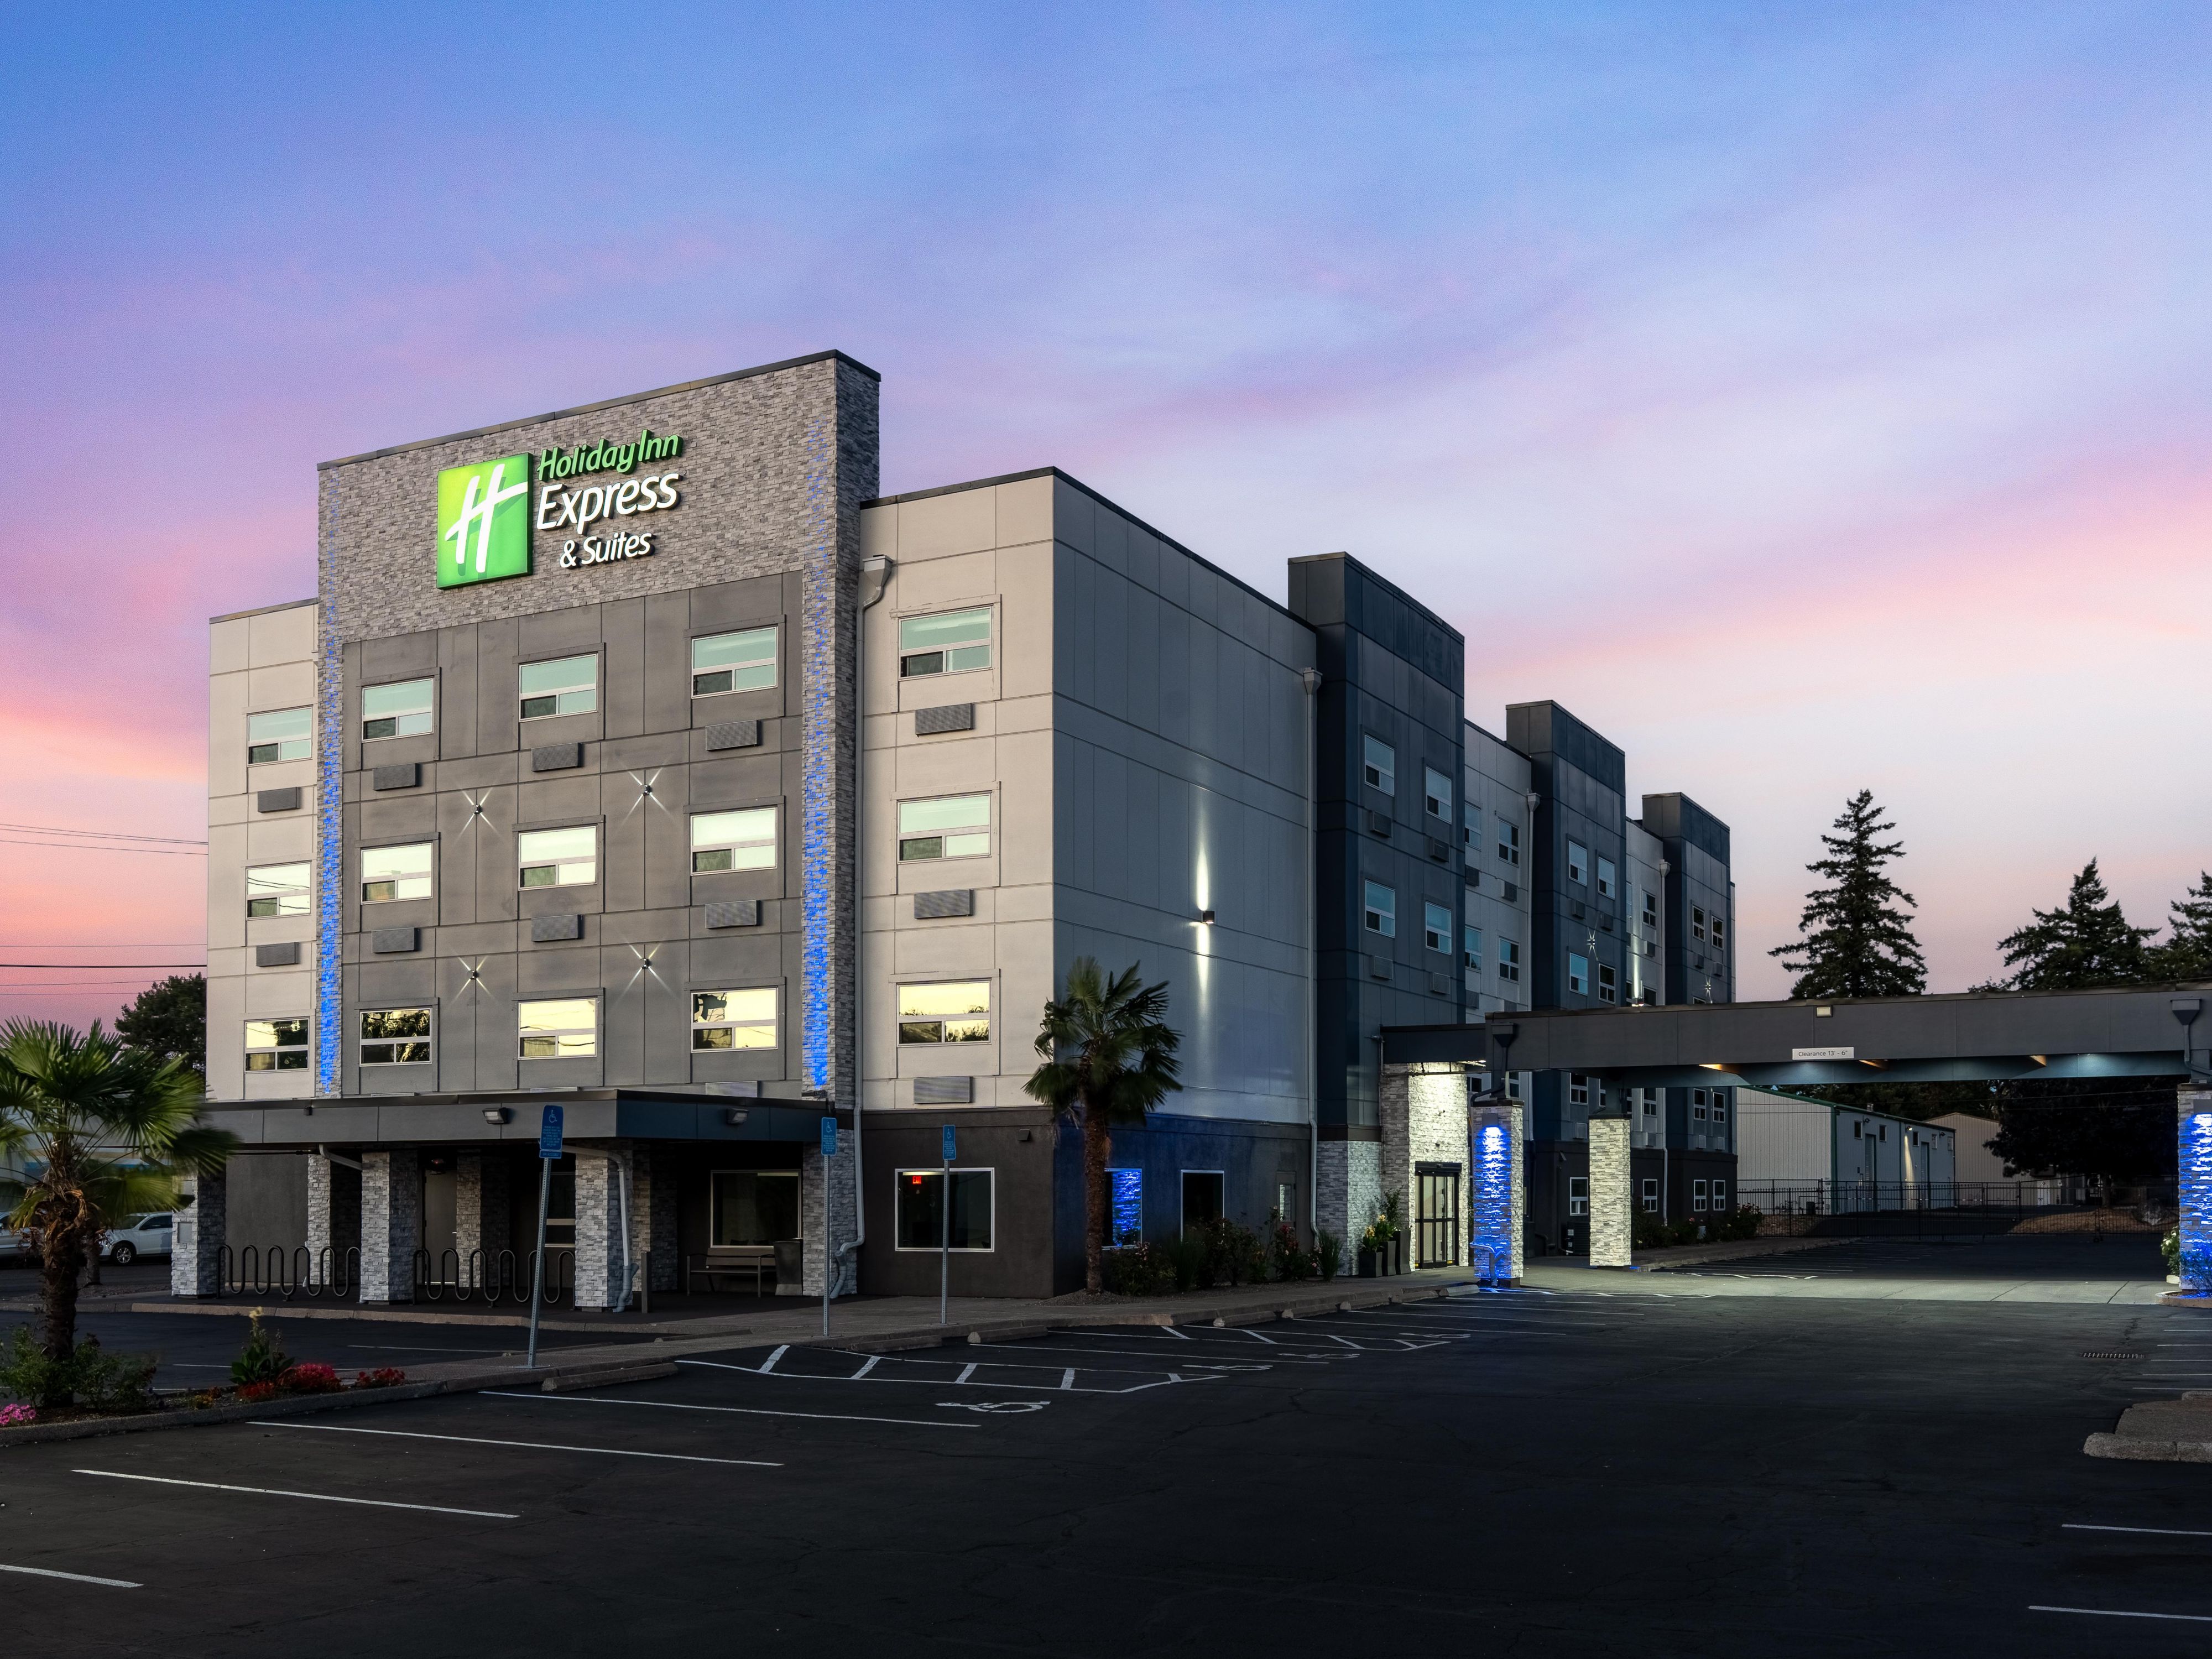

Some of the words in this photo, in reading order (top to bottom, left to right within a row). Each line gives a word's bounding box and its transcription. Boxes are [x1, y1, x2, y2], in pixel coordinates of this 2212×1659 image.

[536, 439, 636, 481] Holiday
[637, 430, 682, 462] Inn
[536, 473, 681, 535] Express
[559, 540, 577, 568] &
[582, 532, 654, 565] Suites
[912, 1176, 921, 1184] EXIT
